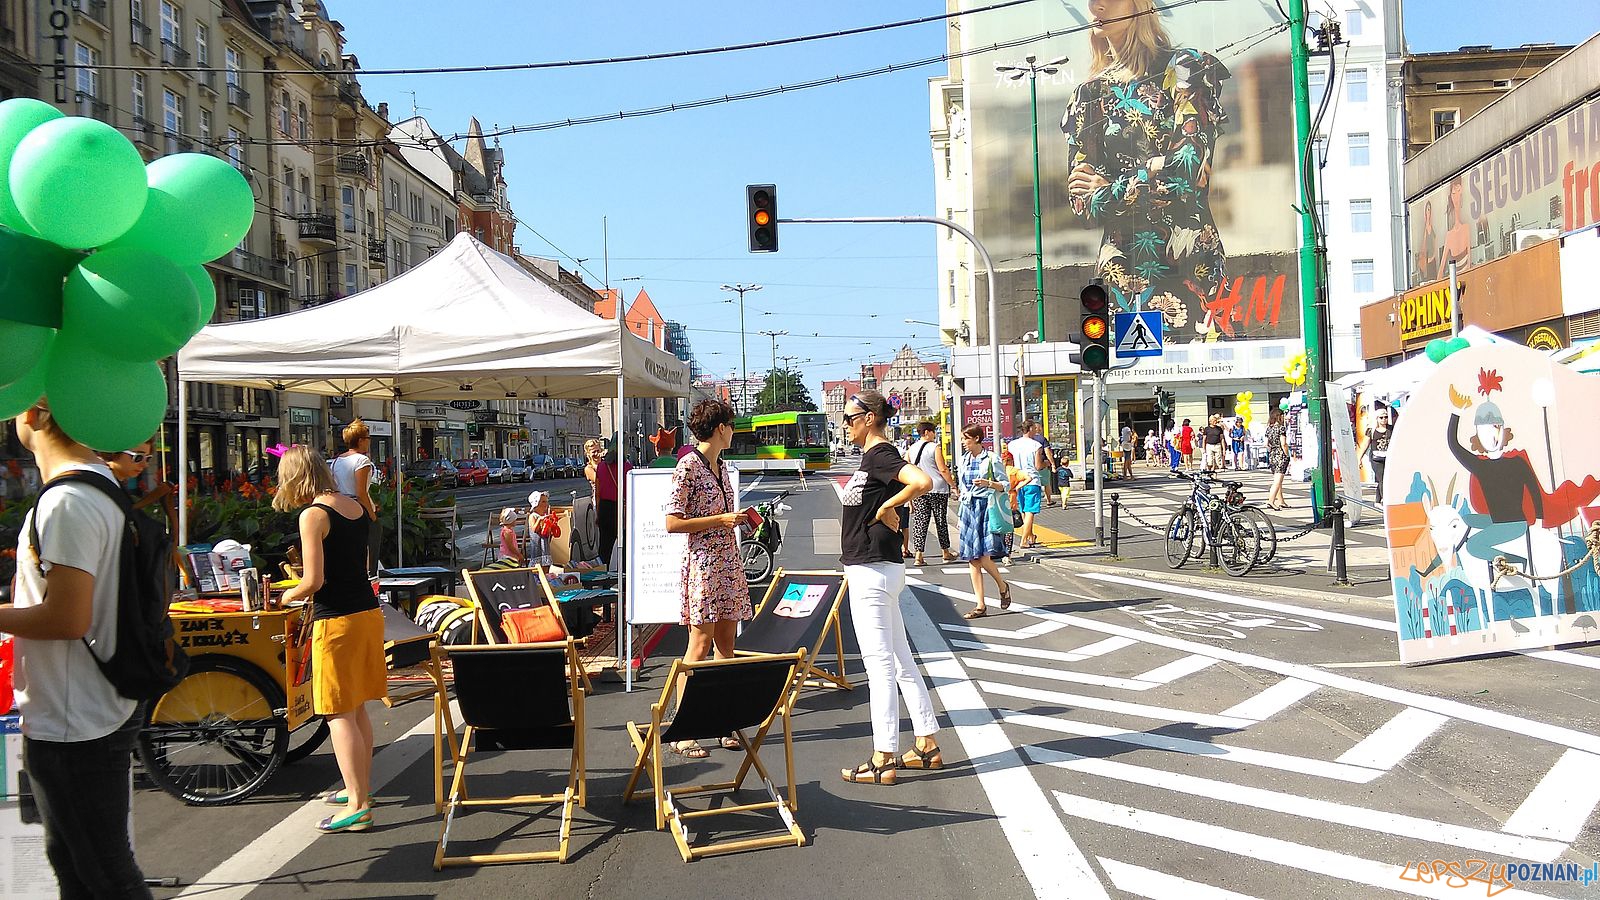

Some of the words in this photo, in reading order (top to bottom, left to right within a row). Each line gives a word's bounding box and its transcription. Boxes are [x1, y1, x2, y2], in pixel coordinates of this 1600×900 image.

[49, 0, 69, 103] OTEL
[1469, 124, 1558, 220] SECOND
[1108, 369, 1131, 380] suje
[1134, 366, 1173, 376] remont
[1177, 363, 1234, 375] kamienicy
[453, 402, 476, 410] HOTEL
[967, 416, 1004, 424] POSNA
[181, 636, 190, 648] Z
